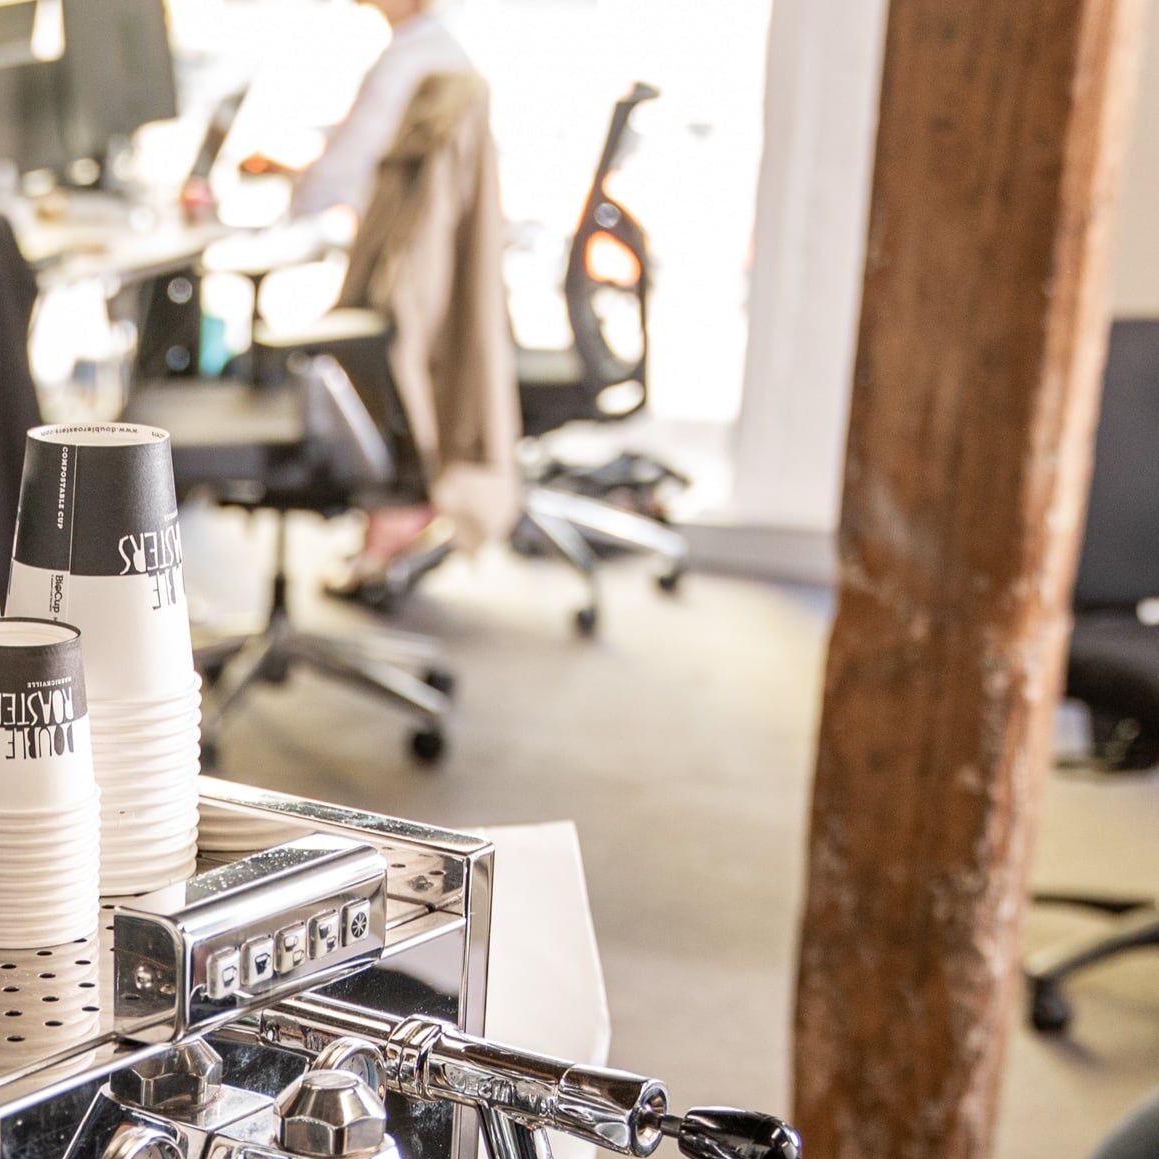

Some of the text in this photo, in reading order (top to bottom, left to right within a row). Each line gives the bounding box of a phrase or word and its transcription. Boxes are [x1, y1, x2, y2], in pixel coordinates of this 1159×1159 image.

[56, 446, 68, 530] COMPOSTABLE CUP
[118, 521, 182, 576] ASTERS
[52, 575, 63, 613] BioCup
[27, 676, 72, 688] MARRICKVILLE
[4, 722, 75, 760] DOUBLE
